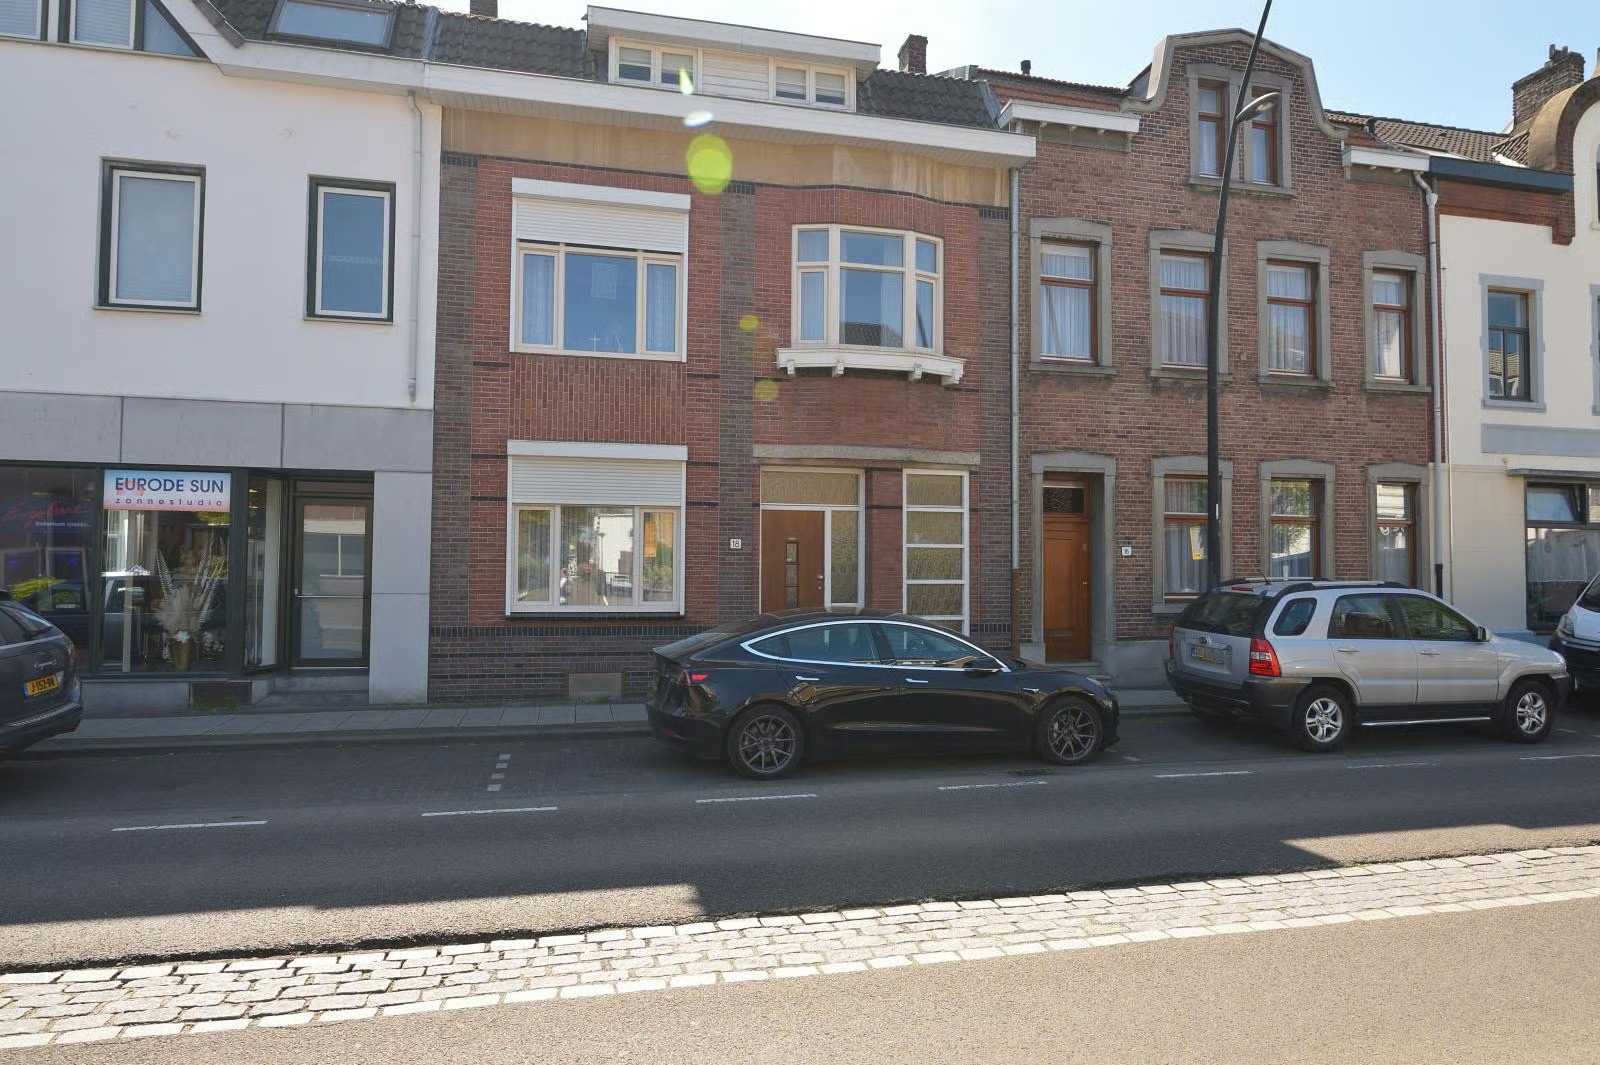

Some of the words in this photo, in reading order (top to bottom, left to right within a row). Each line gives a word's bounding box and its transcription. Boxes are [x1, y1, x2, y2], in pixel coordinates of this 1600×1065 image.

[115, 477, 184, 492] EURODE
[190, 479, 224, 493] SUN
[115, 497, 223, 507] zonnestudio
